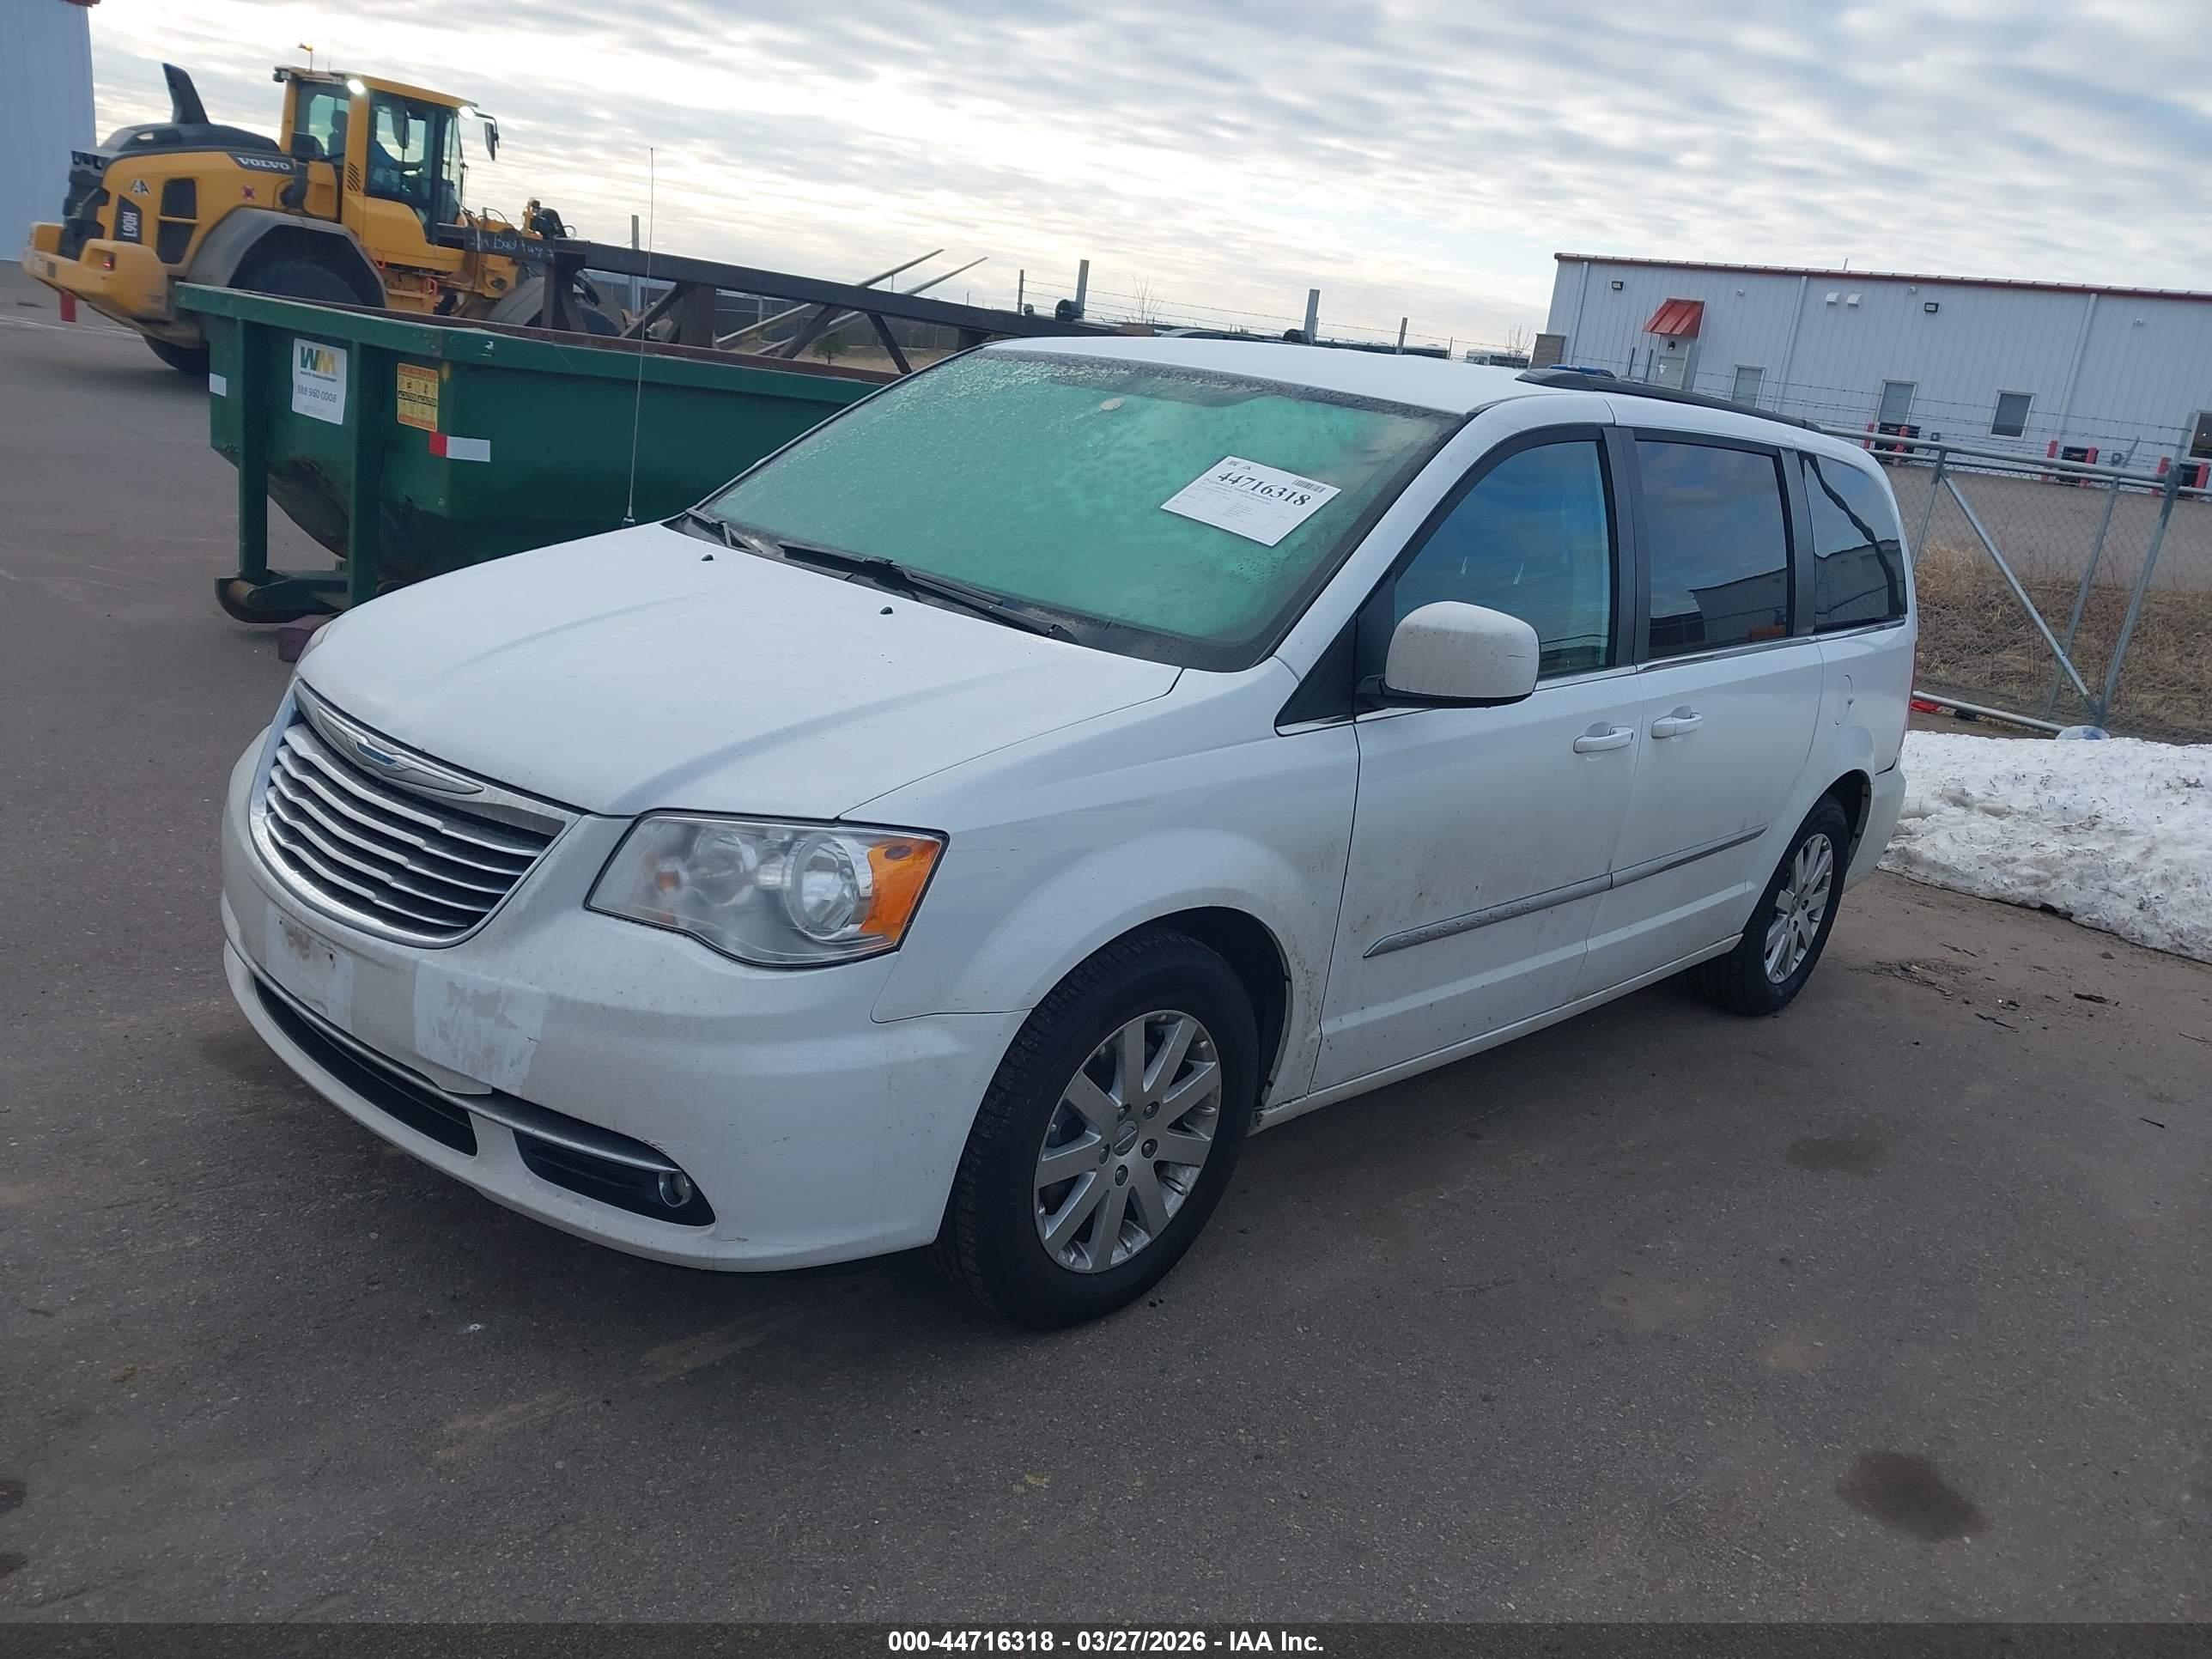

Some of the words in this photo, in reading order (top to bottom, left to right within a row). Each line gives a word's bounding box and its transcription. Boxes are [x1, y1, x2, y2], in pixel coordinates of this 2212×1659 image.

[235, 156, 291, 171] VOLVO
[123, 211, 138, 238] L90H
[300, 345, 337, 373] WM
[320, 391, 337, 404] 0008
[1217, 471, 1311, 506] 44716318
